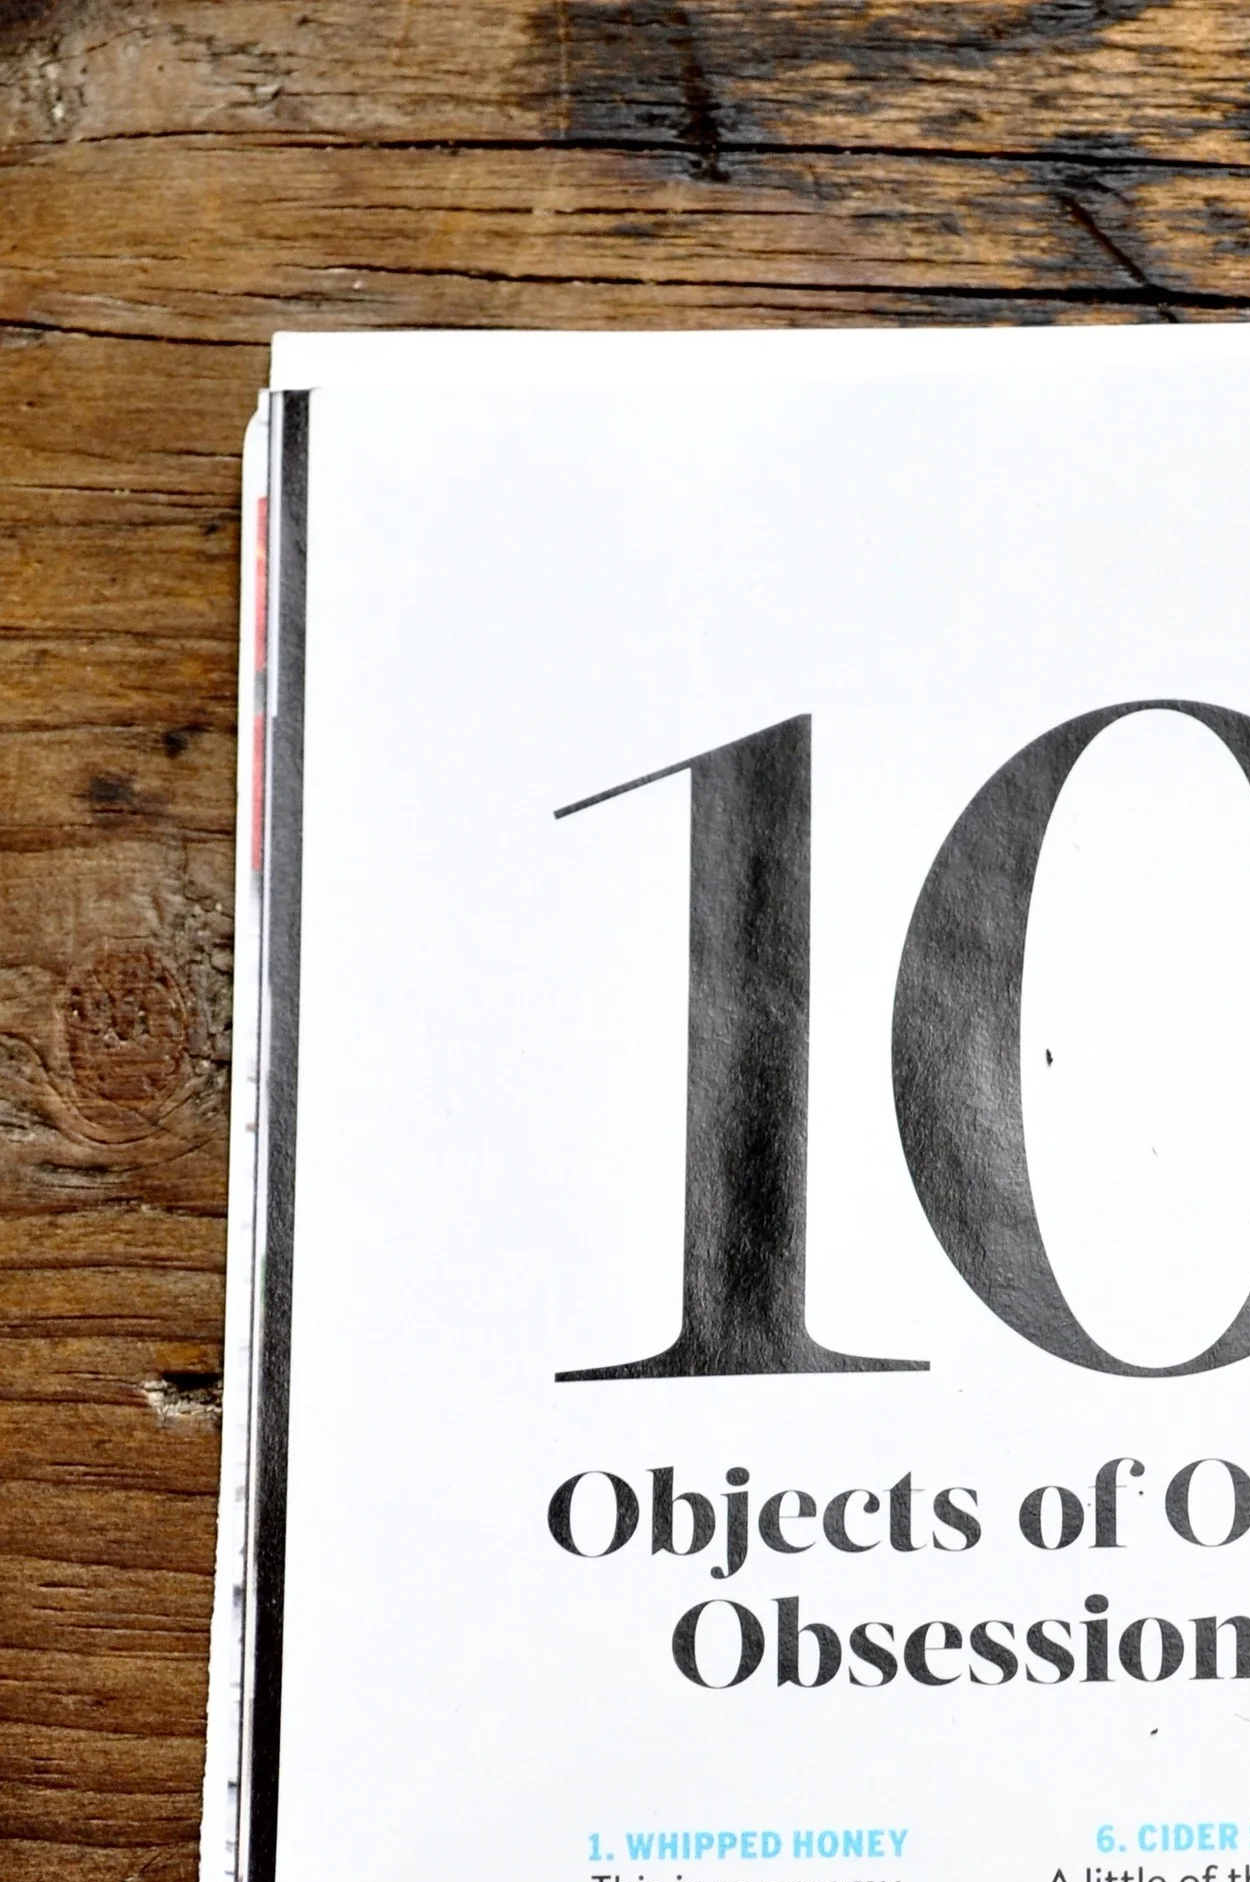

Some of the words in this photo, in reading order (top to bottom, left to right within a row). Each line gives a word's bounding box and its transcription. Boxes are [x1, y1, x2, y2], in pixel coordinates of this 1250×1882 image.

[546, 1464, 982, 1579] Objects
[1018, 1457, 1145, 1549] of
[589, 1832, 614, 1861] 1.
[626, 1829, 782, 1860] WHIPPED
[793, 1828, 908, 1858] HONEY
[1096, 1824, 1126, 1853] 6.
[1138, 1821, 1238, 1852] CIDER
